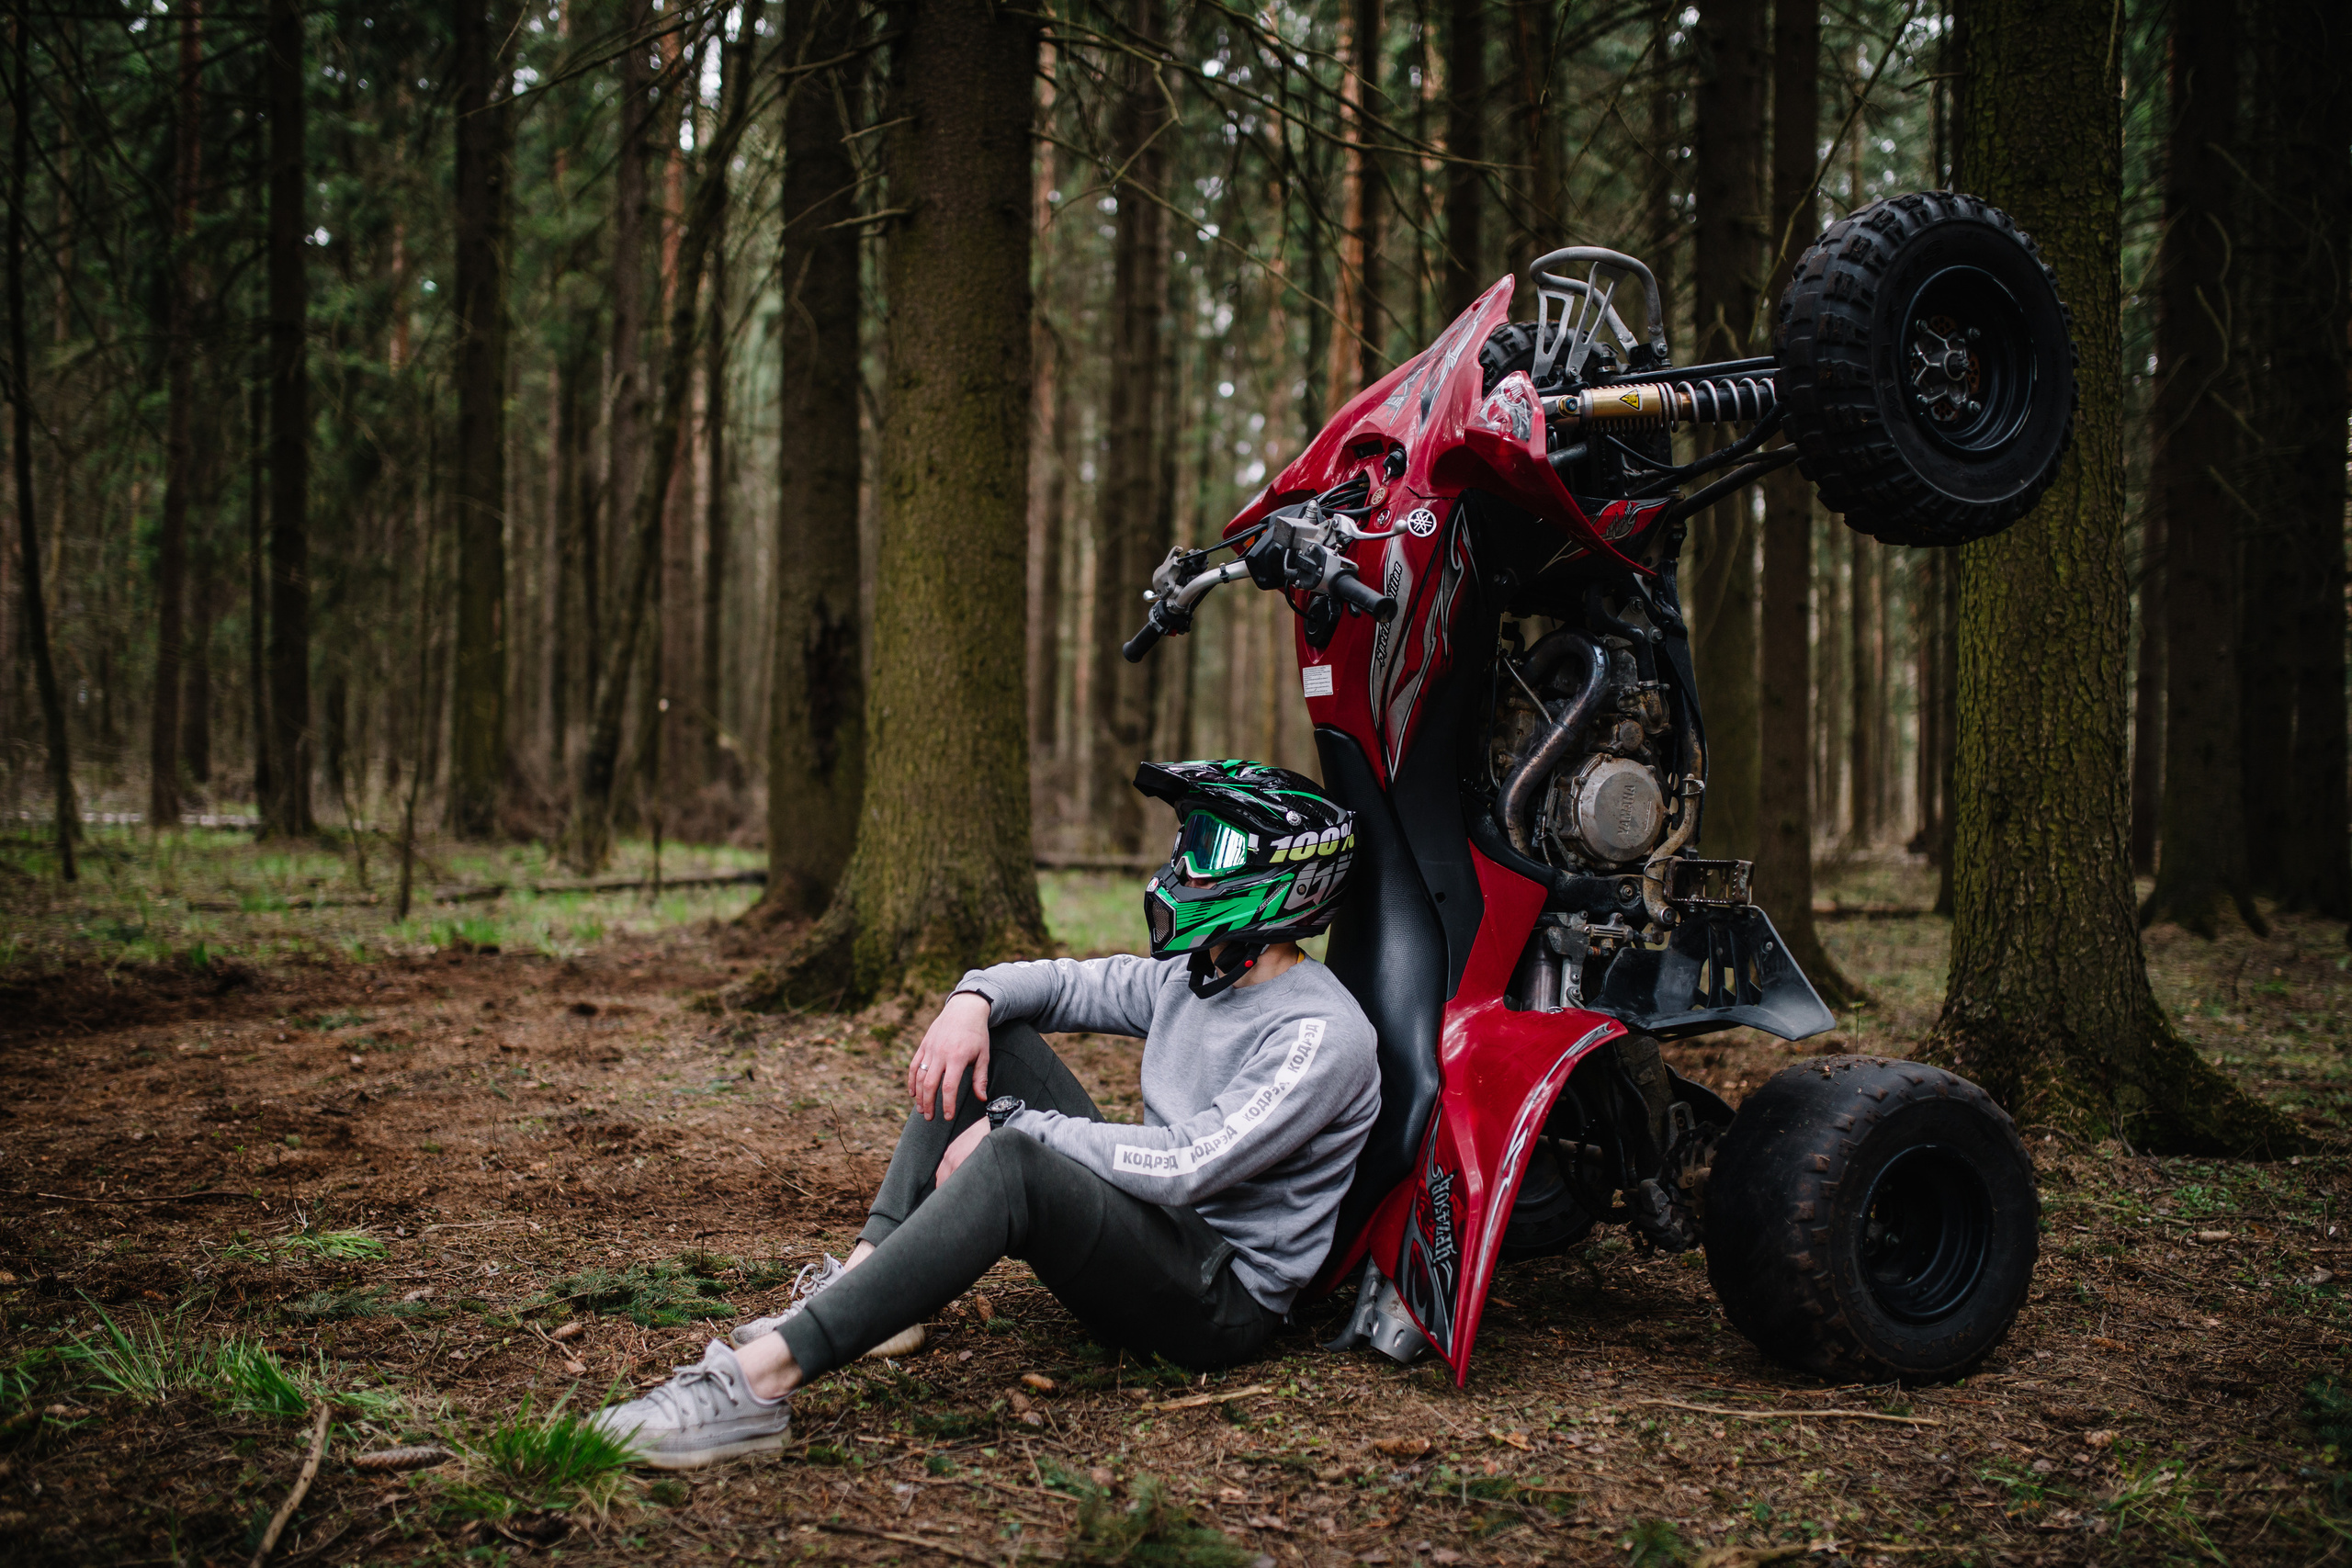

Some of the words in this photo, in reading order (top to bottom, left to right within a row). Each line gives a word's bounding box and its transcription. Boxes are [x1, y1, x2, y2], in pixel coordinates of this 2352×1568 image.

[1376, 622, 1391, 667] Speci
[1385, 560, 1402, 600] ition
[1617, 784, 1636, 835] YAMAHA
[1269, 819, 1355, 863] 100%
[1123, 1150, 1179, 1171] КОДРЭД
[1431, 1173, 1458, 1264] YFZ450R
